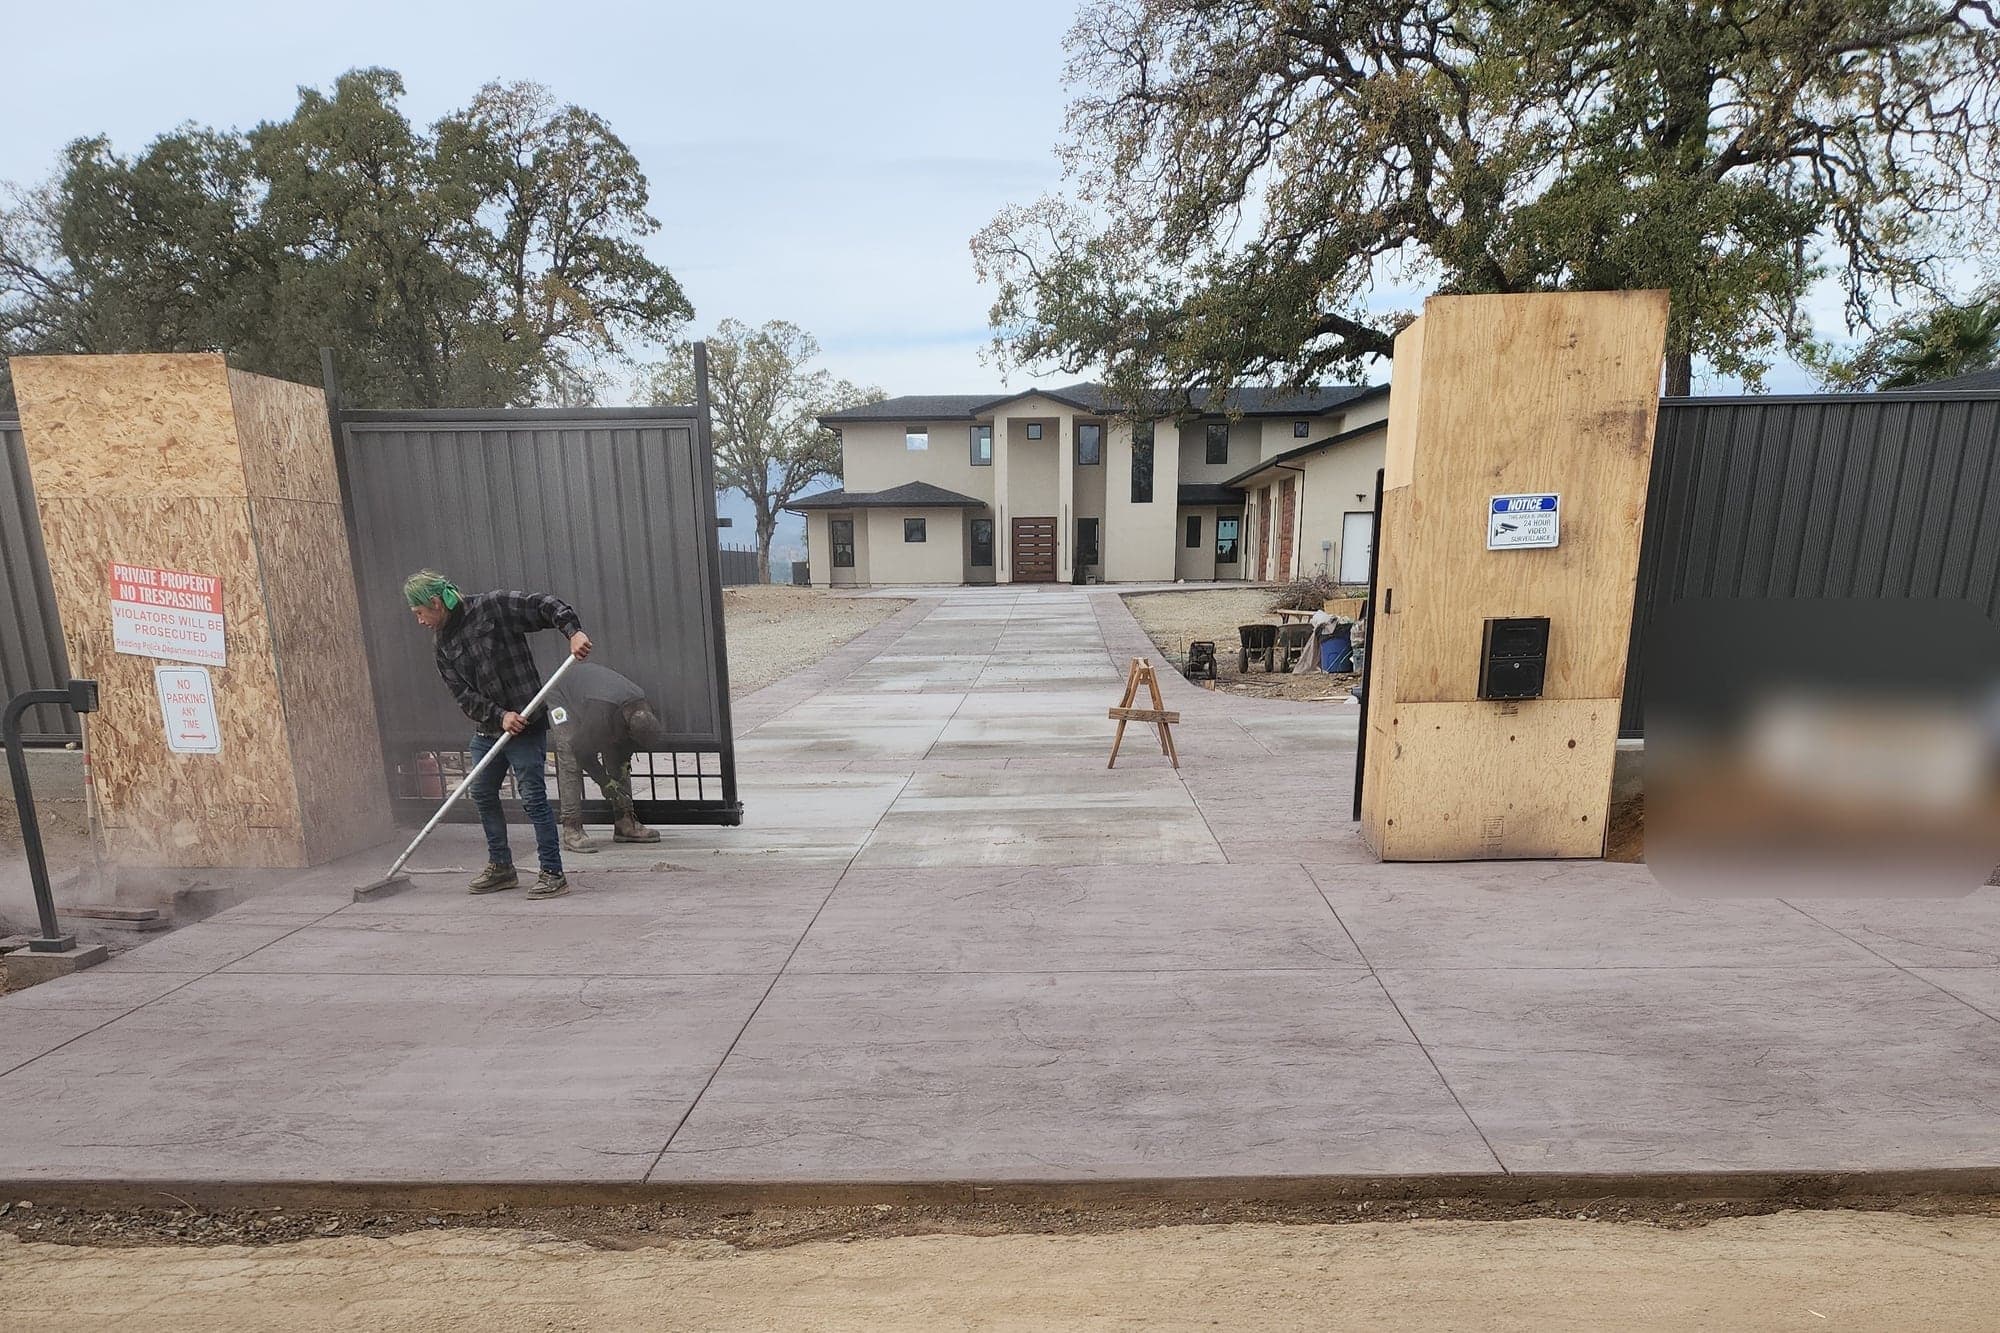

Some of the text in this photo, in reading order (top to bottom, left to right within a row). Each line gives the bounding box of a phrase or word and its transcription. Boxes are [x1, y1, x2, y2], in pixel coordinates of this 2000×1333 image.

[1508, 498, 1543, 511] NOTICE
[1523, 519, 1551, 527] 24 HOUR
[1527, 527, 1547, 535] VIDEO
[114, 564, 215, 594] PRIVATE PROPERTY
[119, 583, 213, 612] NO TRESPASSING
[114, 606, 223, 632] VIOLATORS WILL BE
[134, 623, 208, 643] PROSECUTED
[142, 641, 160, 651] Police
[162, 644, 198, 656] Department
[176, 679, 191, 690] NO
[166, 692, 207, 704] PARKING
[182, 707, 196, 717] ANY
[182, 719, 200, 729] TIME
